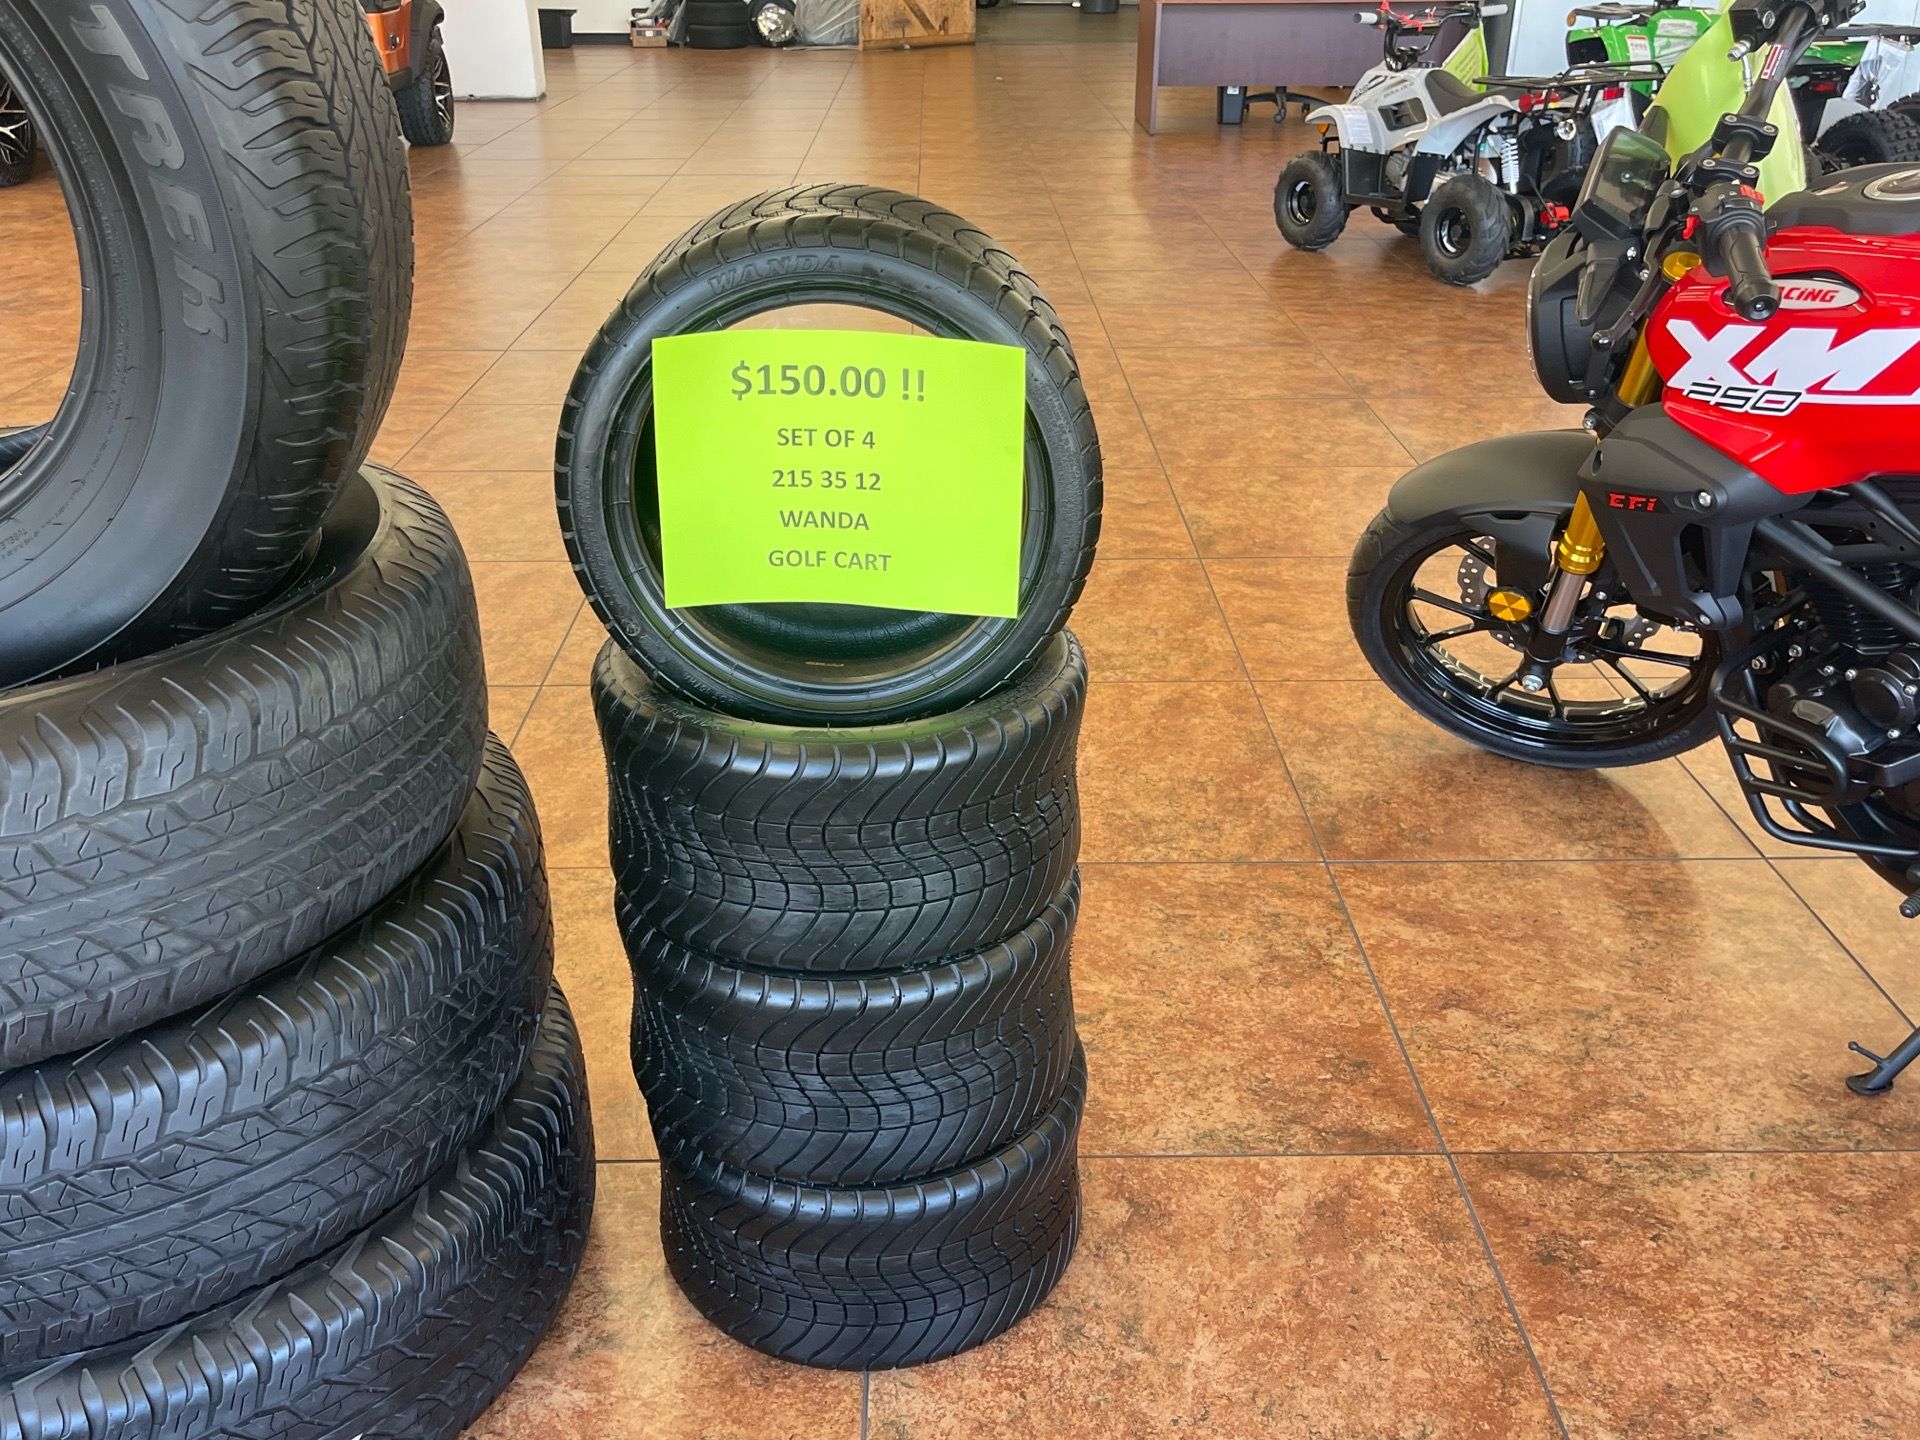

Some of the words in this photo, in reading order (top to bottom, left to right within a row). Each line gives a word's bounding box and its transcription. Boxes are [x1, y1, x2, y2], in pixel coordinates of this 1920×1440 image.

[707, 254, 842, 296] WANDA
[731, 360, 887, 401] $150.00
[902, 368, 925, 402] !!
[1686, 382, 1803, 412] 250
[777, 428, 818, 447] SET
[825, 429, 855, 448] OF
[862, 431, 876, 449] 4
[772, 469, 813, 488] 215
[820, 470, 847, 489] 35
[855, 472, 881, 491] 12
[779, 510, 870, 531] WANDA
[768, 549, 827, 568] GOLF
[834, 551, 892, 572] CART
